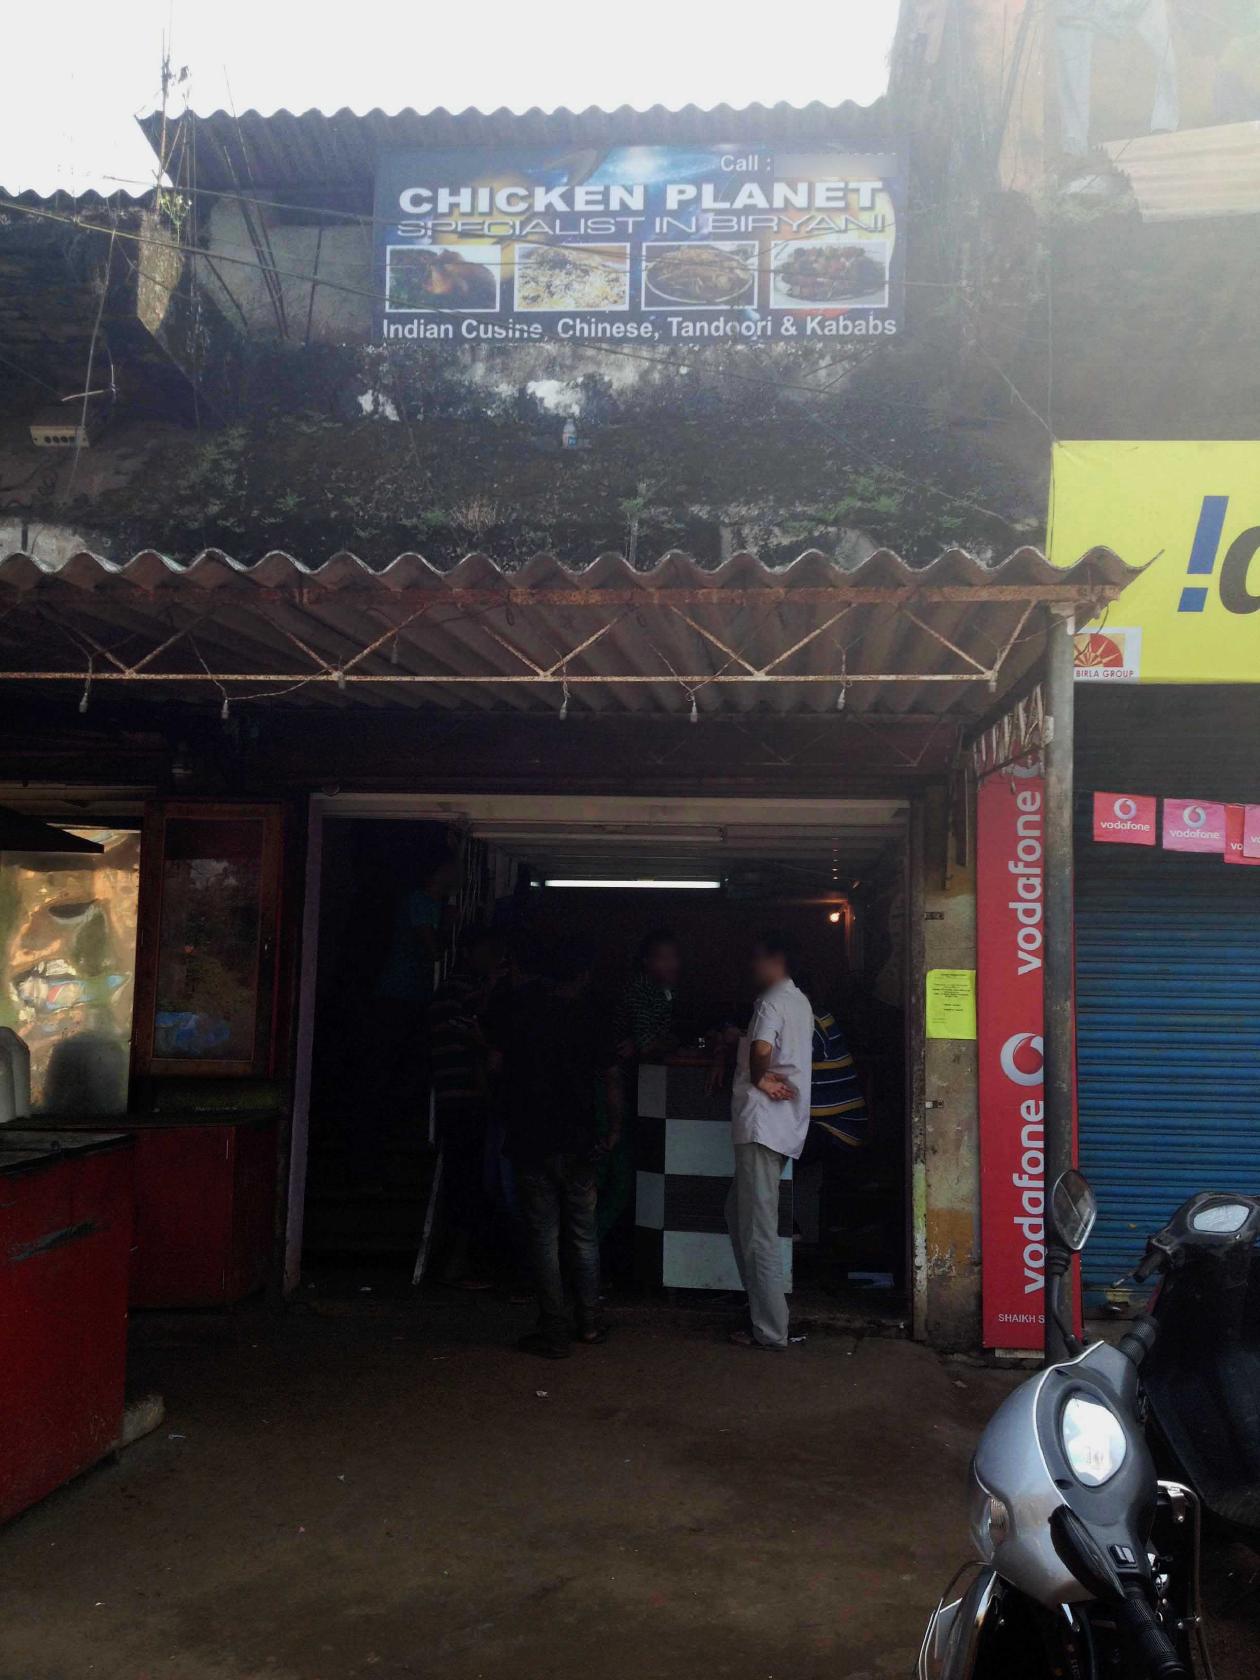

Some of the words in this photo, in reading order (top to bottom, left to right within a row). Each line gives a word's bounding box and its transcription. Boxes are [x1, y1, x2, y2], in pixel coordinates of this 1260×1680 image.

[720, 154, 758, 171] Call
[399, 184, 644, 214] CHICKEN
[665, 181, 883, 210] PLANET
[397, 217, 645, 237] SPECIALIST
[655, 215, 696, 233] IN
[709, 214, 886, 233] BIRYANI
[383, 319, 453, 339] Indian
[557, 317, 660, 340] Chinese,
[667, 316, 772, 337] Tandoori
[781, 317, 797, 336] &
[806, 315, 897, 336] Kababs
[1075, 670, 1099, 678] BIRLA
[1102, 670, 1134, 678] GROUP
[1100, 821, 1151, 832] vodafone
[1169, 829, 1221, 839] vodafone
[1008, 790, 1042, 975] vodafone
[1013, 1099, 1045, 1294] vodafone
[998, 1313, 1036, 1324] SHAIKH
